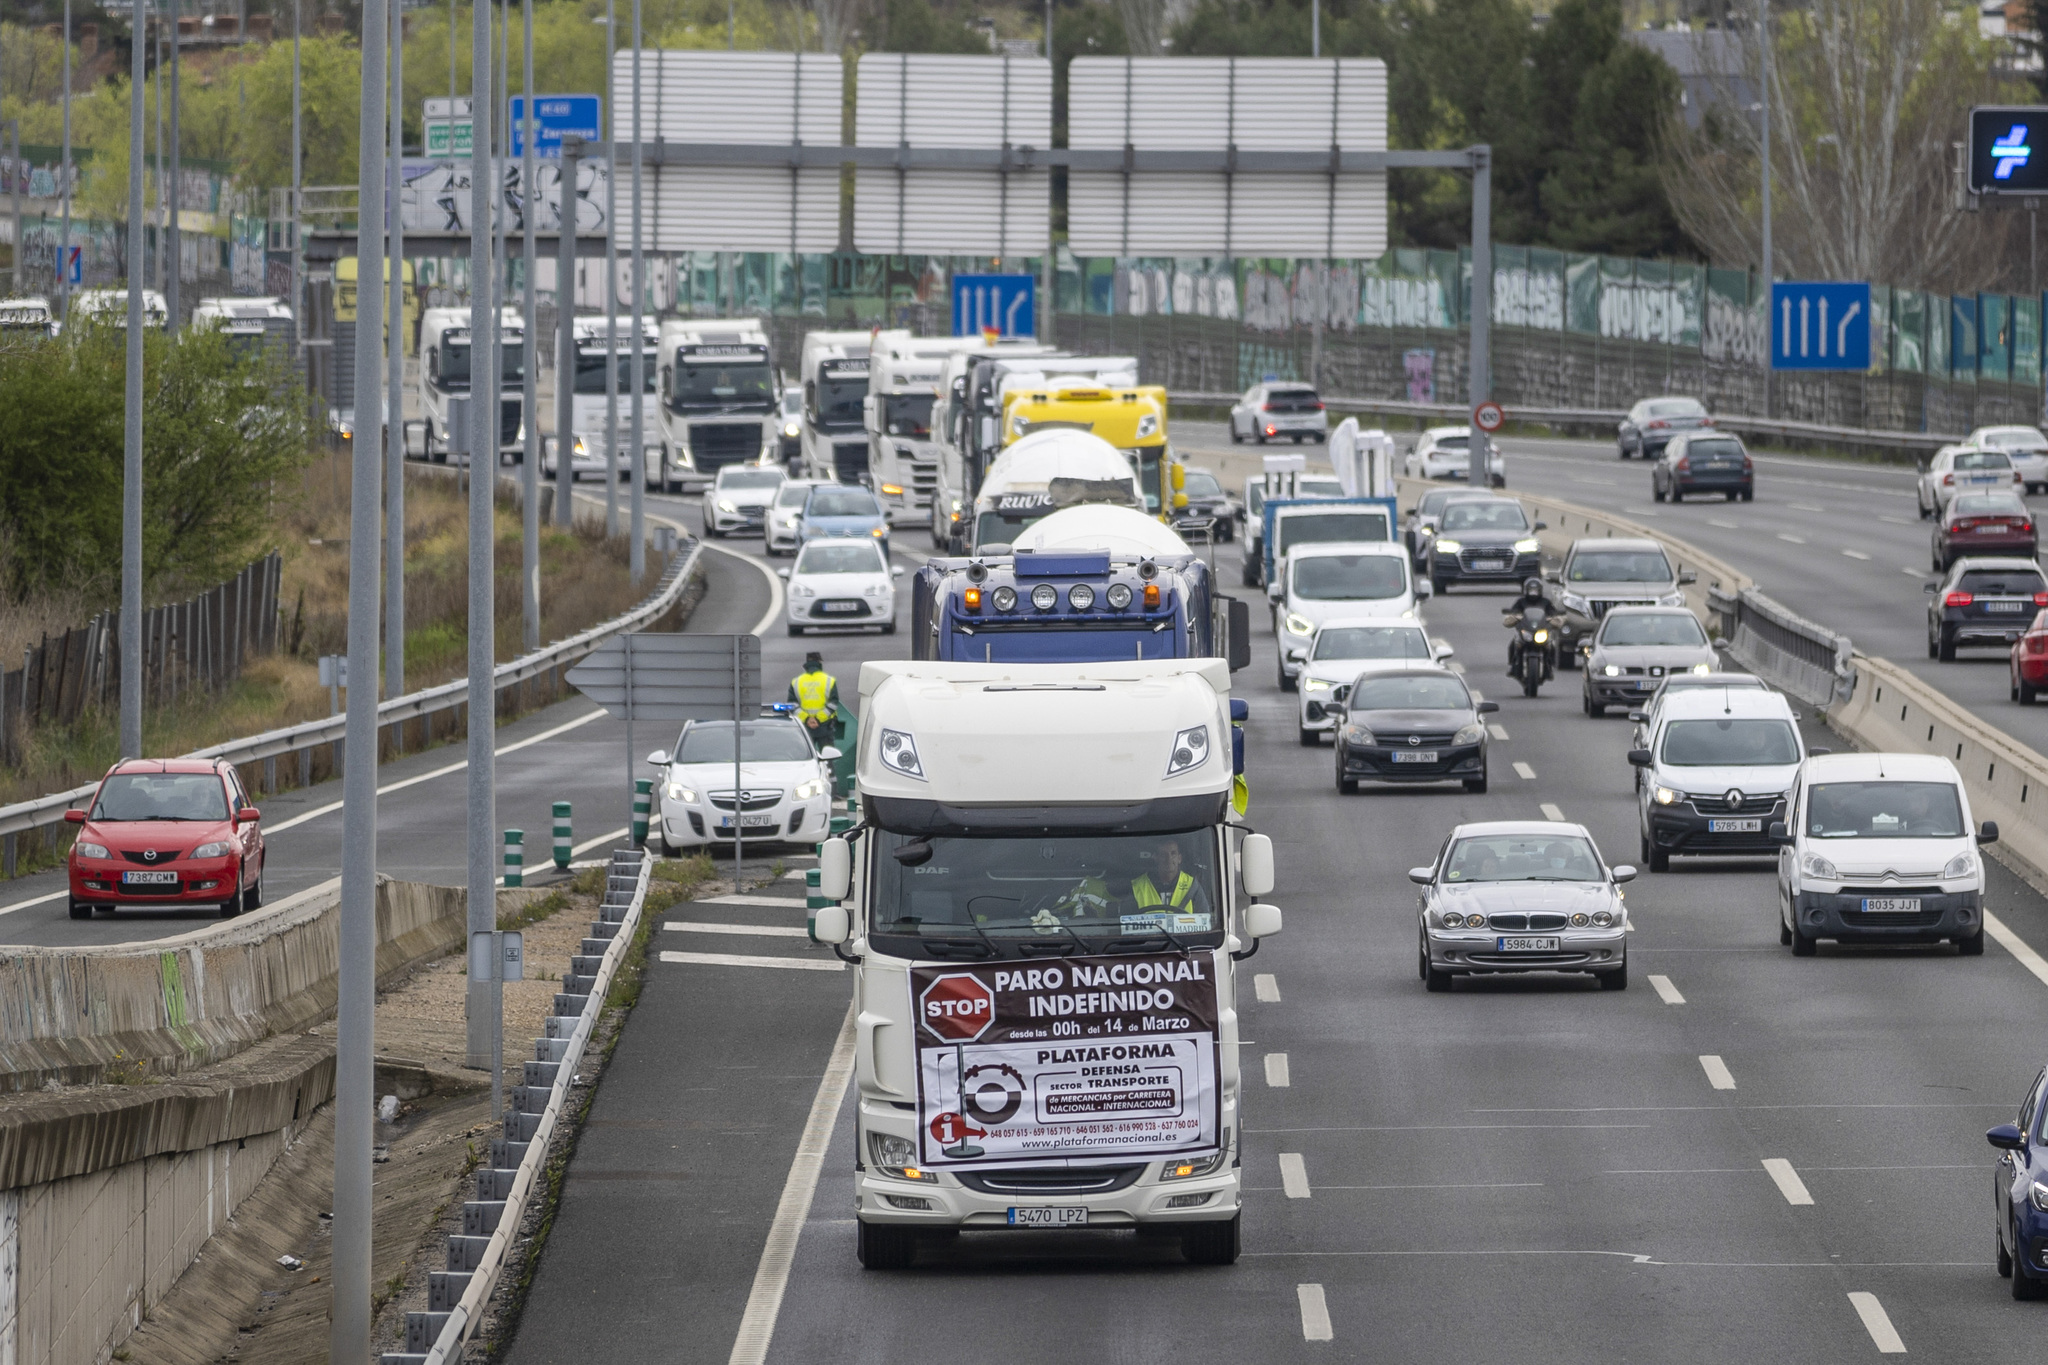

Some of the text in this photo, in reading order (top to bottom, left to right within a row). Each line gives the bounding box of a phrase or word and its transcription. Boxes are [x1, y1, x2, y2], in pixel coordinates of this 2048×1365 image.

[1715, 821, 1757, 831] 5785 LWH
[914, 866, 949, 875] DAF
[129, 872, 175, 883] 7387 CMW
[1868, 900, 1918, 910] 8035 JJT
[1175, 925, 1208, 933] MADRID
[1506, 939, 1555, 950] 5984 CJW
[995, 960, 1205, 992] PARO NACIONAL
[927, 998, 988, 1017] STOP
[1029, 988, 1175, 1017] INDEFINIDO
[1010, 1016, 1190, 1039] desde las 00h del 14 de Marzo
[1037, 1043, 1175, 1065] PLATAFORMA
[1081, 1064, 1141, 1077] DEFENSA
[1050, 1076, 1169, 1091] SECTOR TRANSPORTE
[1049, 1096, 1059, 1104] de
[1113, 1093, 1127, 1102] por
[1128, 1090, 1172, 1100] CARRETERA
[1049, 1103, 1095, 1113] NACIONAL
[1103, 1100, 1172, 1111] INTERNACIONAL
[990, 1129, 1002, 1139] 648
[1003, 1129, 1015, 1138] 057
[1016, 1128, 1028, 1137] 615
[1033, 1128, 1045, 1136] 659
[1046, 1127, 1058, 1136] 165
[1059, 1126, 1071, 1135] 710
[1076, 1125, 1088, 1134] 646
[1089, 1125, 1100, 1133] 051
[1102, 1124, 1114, 1133] 562
[1119, 1123, 1131, 1132] 616
[1132, 1122, 1143, 1131] 990
[1161, 1121, 1173, 1130] 637
[1174, 1120, 1186, 1129] 760
[1187, 1119, 1198, 1128] 024
[1022, 1132, 1177, 1149] www.plataformanacional.es
[1019, 1209, 1083, 1222] 5470 LPZ
